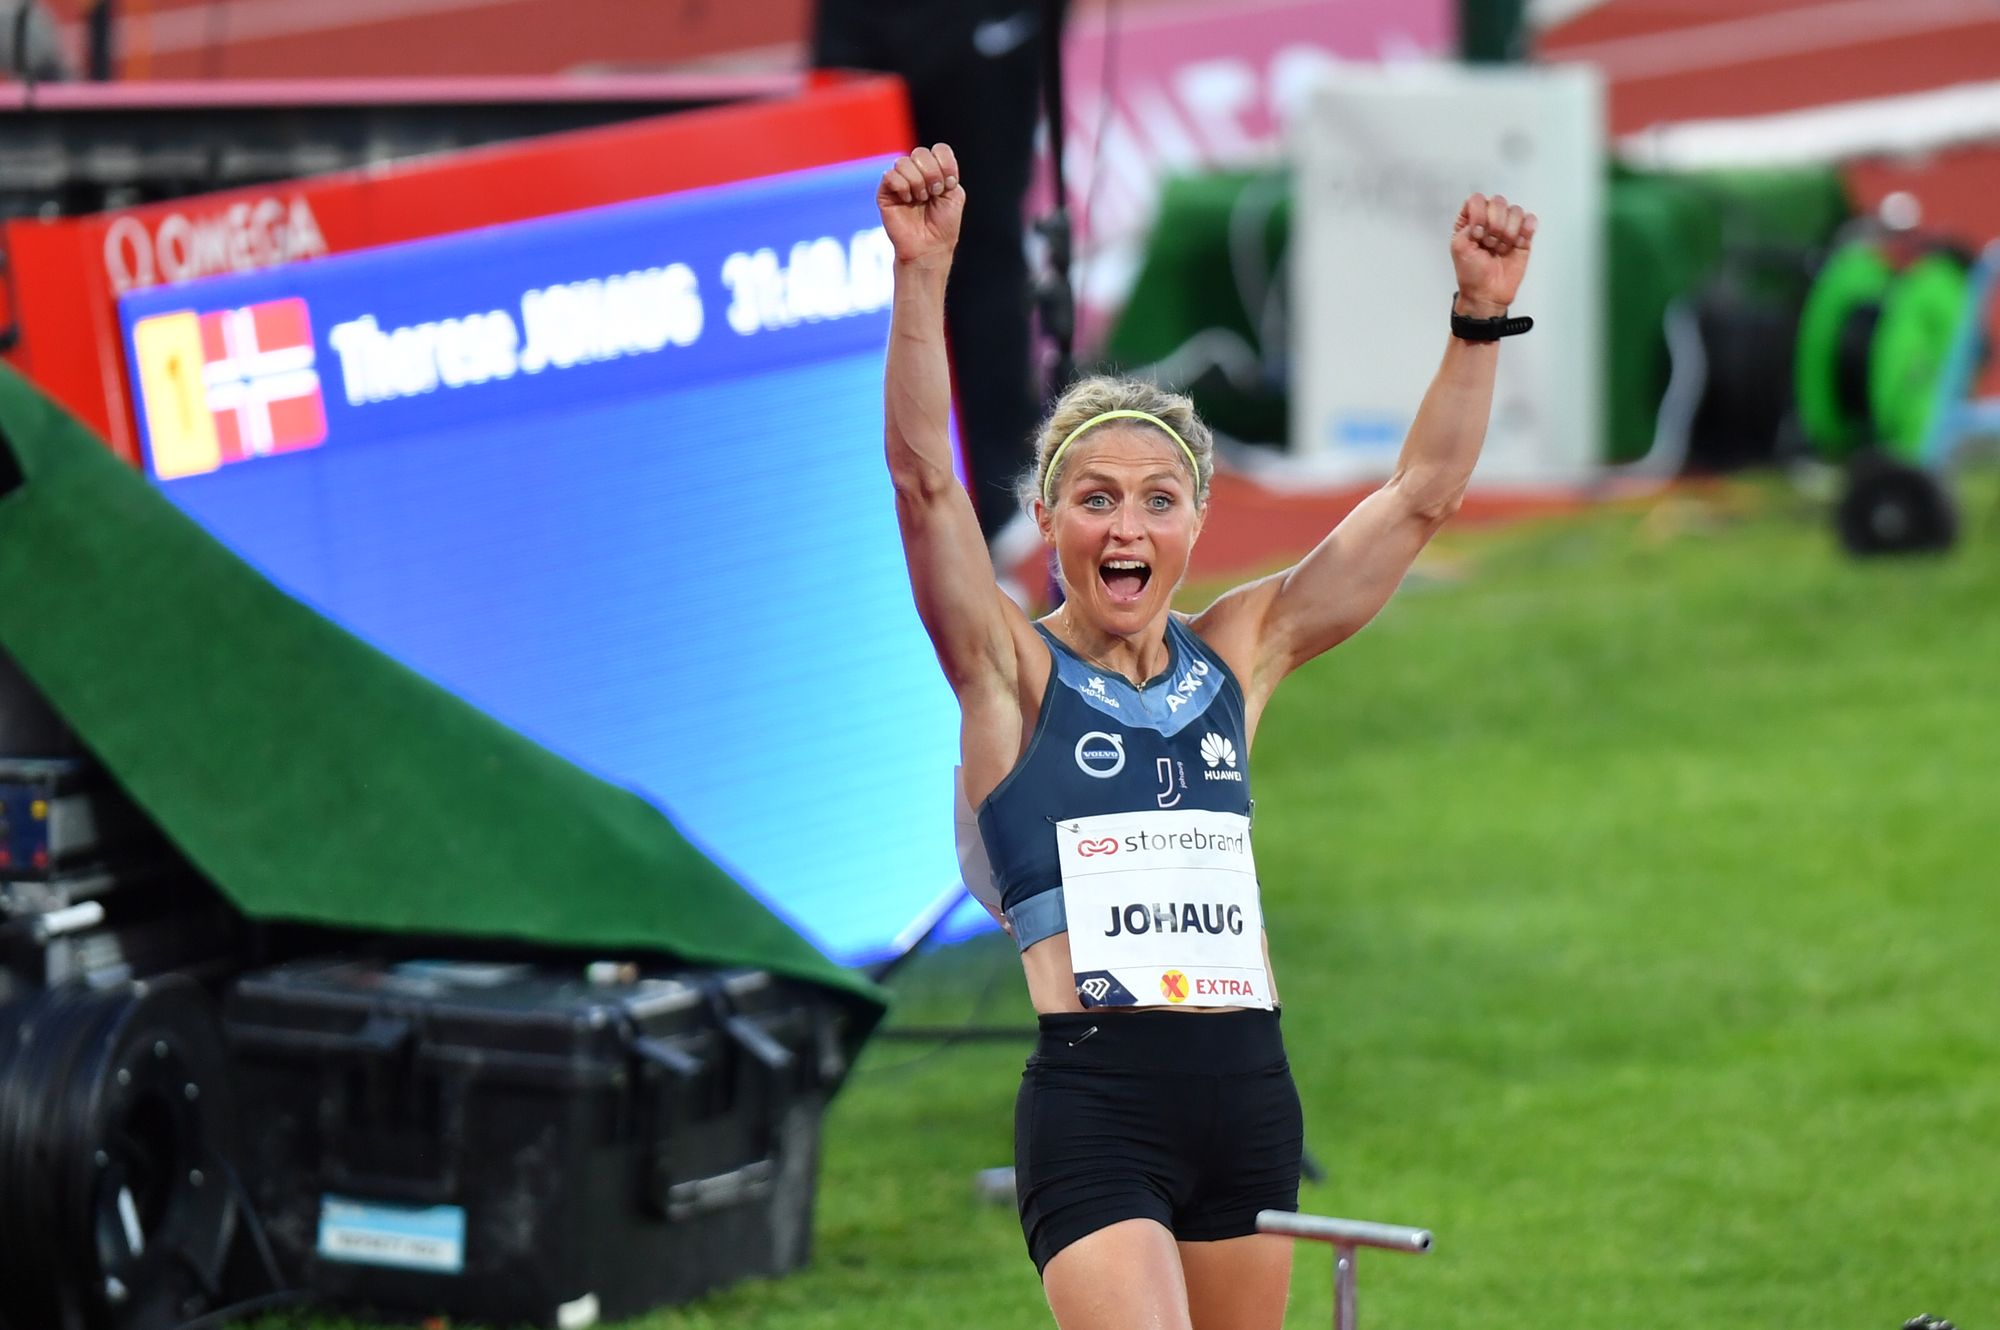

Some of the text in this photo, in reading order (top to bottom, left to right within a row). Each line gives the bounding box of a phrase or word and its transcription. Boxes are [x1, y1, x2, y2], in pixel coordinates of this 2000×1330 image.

[155, 193, 328, 284] OMEGA
[520, 263, 704, 374] JOHAUG
[1165, 659, 1209, 713] ASKO
[1204, 770, 1242, 782] HUAWEI
[1124, 827, 1243, 854] storebrand
[1104, 902, 1243, 937] JOHAUG
[1195, 979, 1254, 996] EXTRA
